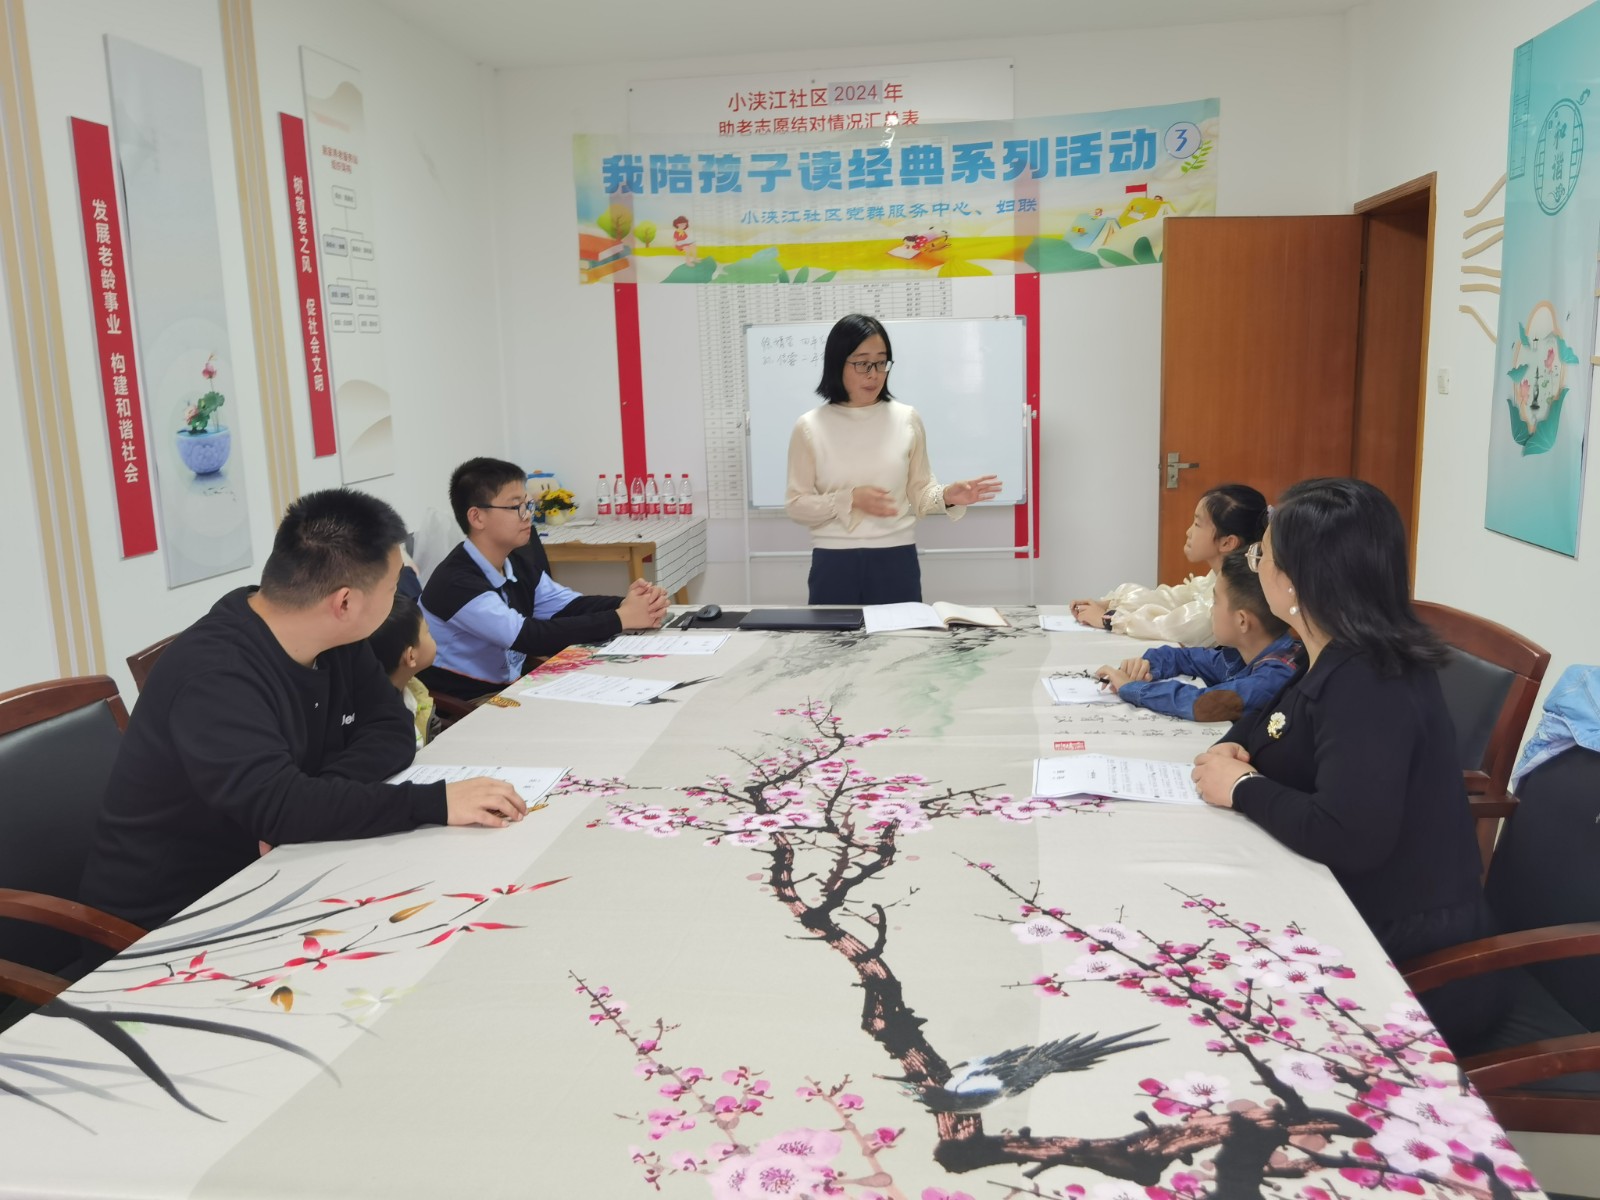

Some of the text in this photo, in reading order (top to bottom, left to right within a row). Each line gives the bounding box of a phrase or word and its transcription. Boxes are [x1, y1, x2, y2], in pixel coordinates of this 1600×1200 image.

[602, 128, 1157, 195] 我陪孩子读经典系列活动
[740, 198, 1038, 225] 小浃江社区党群服务中心、妇联
[92, 199, 139, 483] 发展老龄事业 构建和谐社会
[306, 298, 325, 392] 促社会文明
